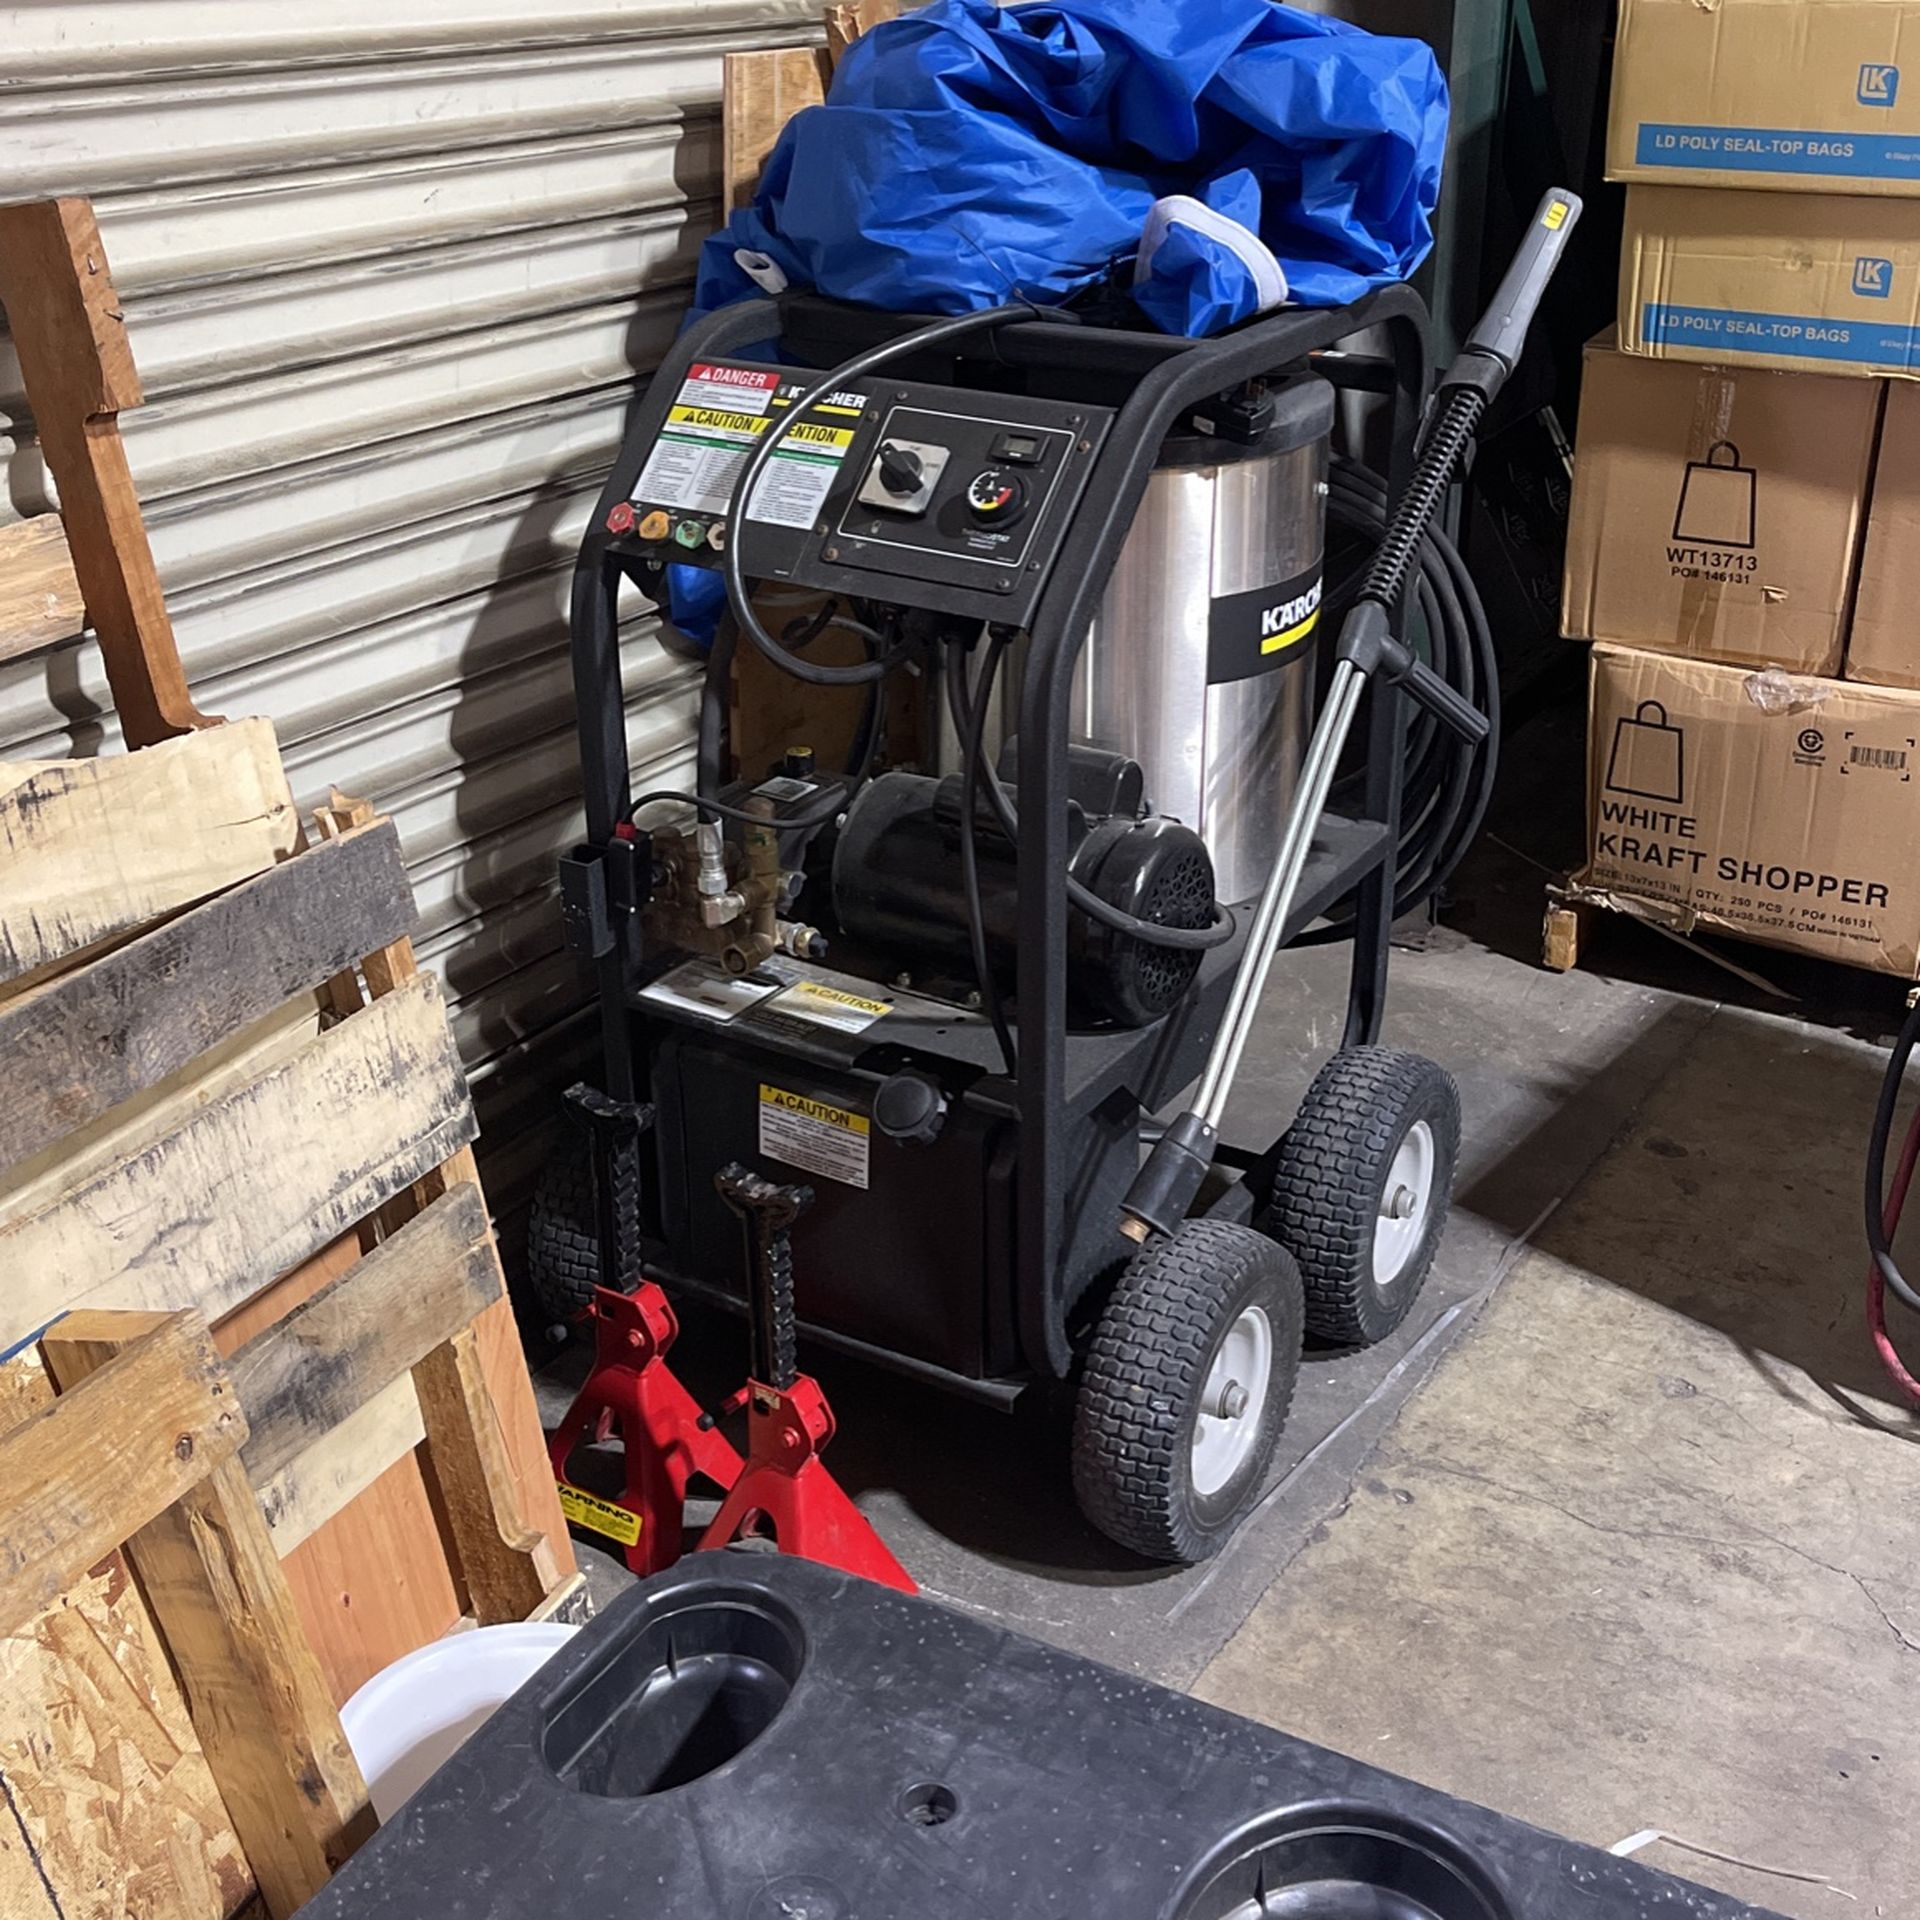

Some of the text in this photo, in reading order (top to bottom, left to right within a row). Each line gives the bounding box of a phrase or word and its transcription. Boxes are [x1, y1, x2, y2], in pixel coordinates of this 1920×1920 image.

[1655, 134, 1854, 158] LD POLY SEAL-TOP BAGS
[1660, 313, 1850, 344] LD POLY SEAL-TOP BAGS
[713, 368, 767, 387] DANGER
[696, 410, 755, 430] CAUTION
[1666, 547, 1758, 572] WT13713
[1671, 566, 1750, 585] PO# 146131
[1601, 800, 1697, 839] WHITE
[1599, 832, 1707, 874] KRAFT
[1717, 857, 1889, 908] SHOPPER
[1757, 900, 1782, 913] PCS
[1801, 909, 1826, 921] PO#
[1832, 914, 1872, 929] 146131
[818, 988, 882, 1013] CAUTION
[785, 1095, 850, 1127] CAUTION
[557, 1485, 635, 1524] ARNING
